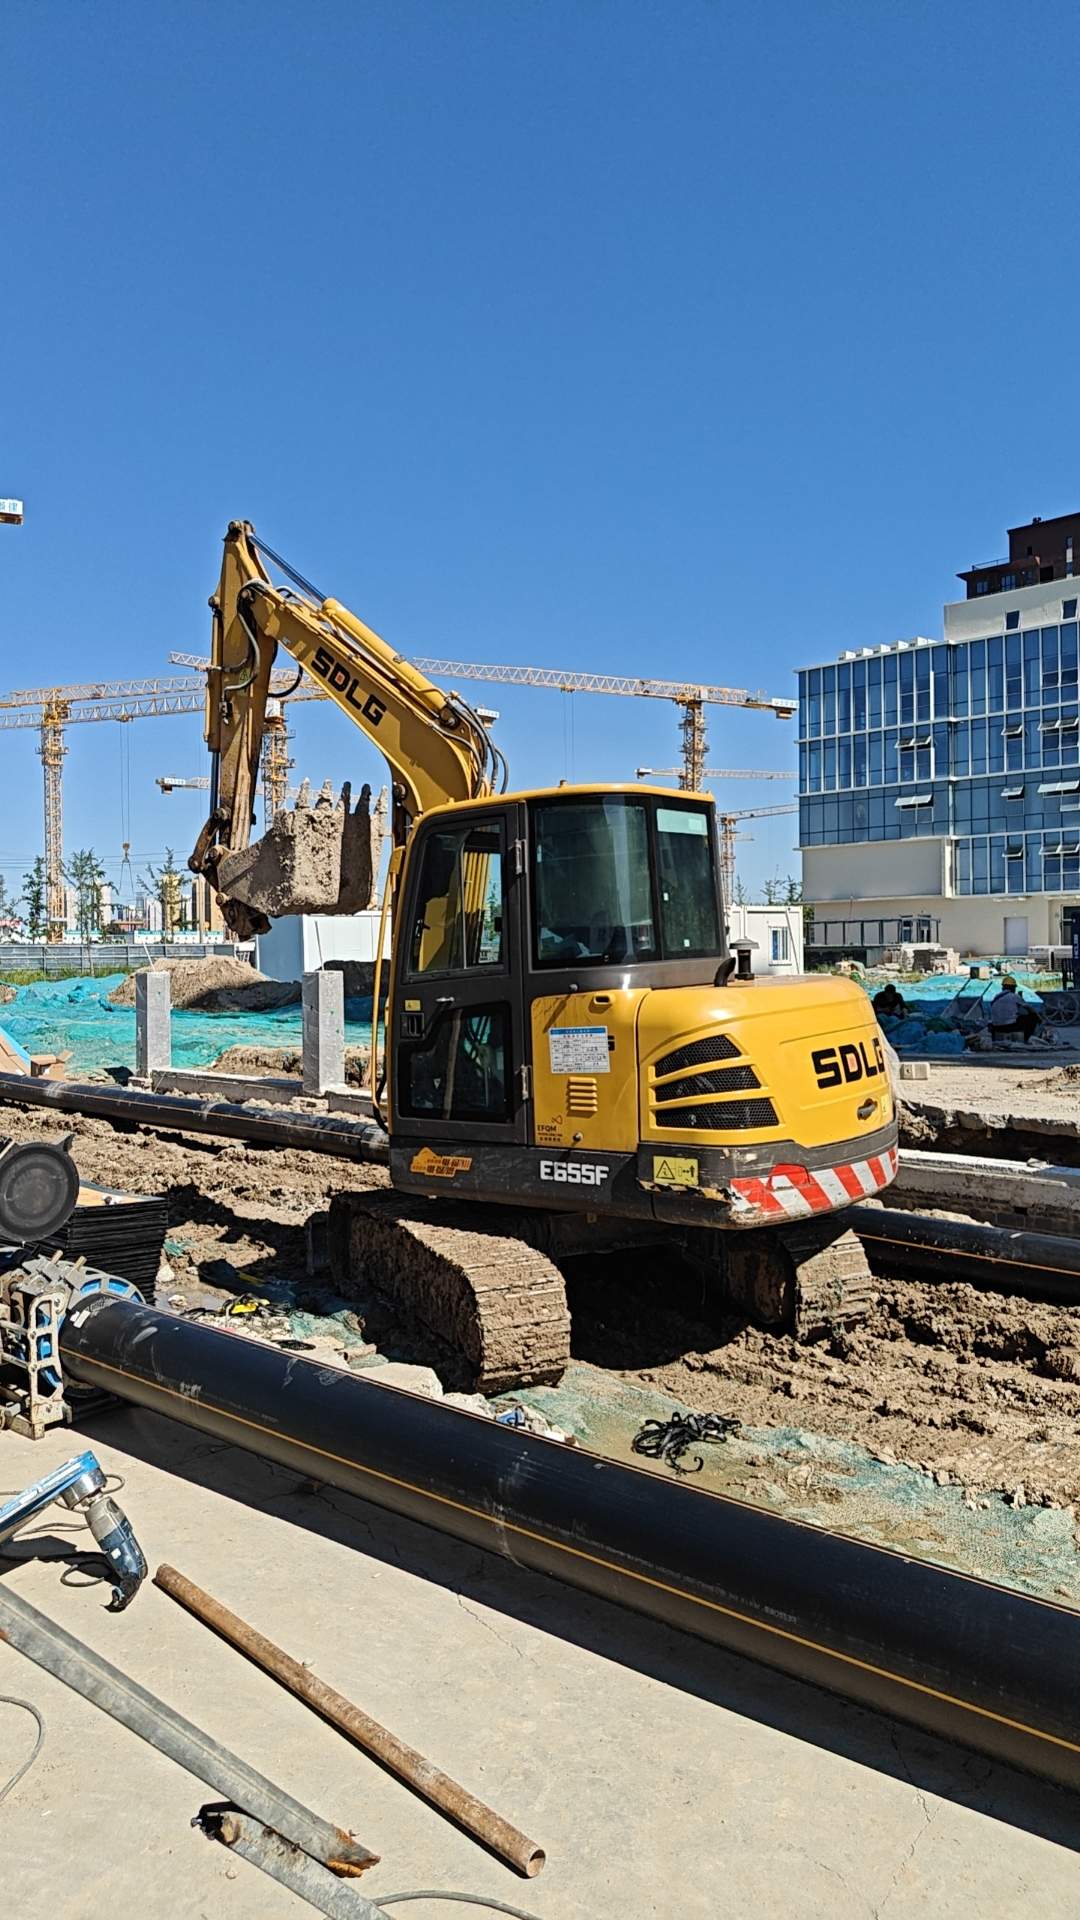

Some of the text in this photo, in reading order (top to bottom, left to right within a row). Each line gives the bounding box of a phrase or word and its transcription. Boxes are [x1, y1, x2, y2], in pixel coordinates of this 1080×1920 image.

[311, 646, 387, 726] SDLG
[811, 1037, 886, 1089] SDLG
[540, 1160, 610, 1186] E655F
